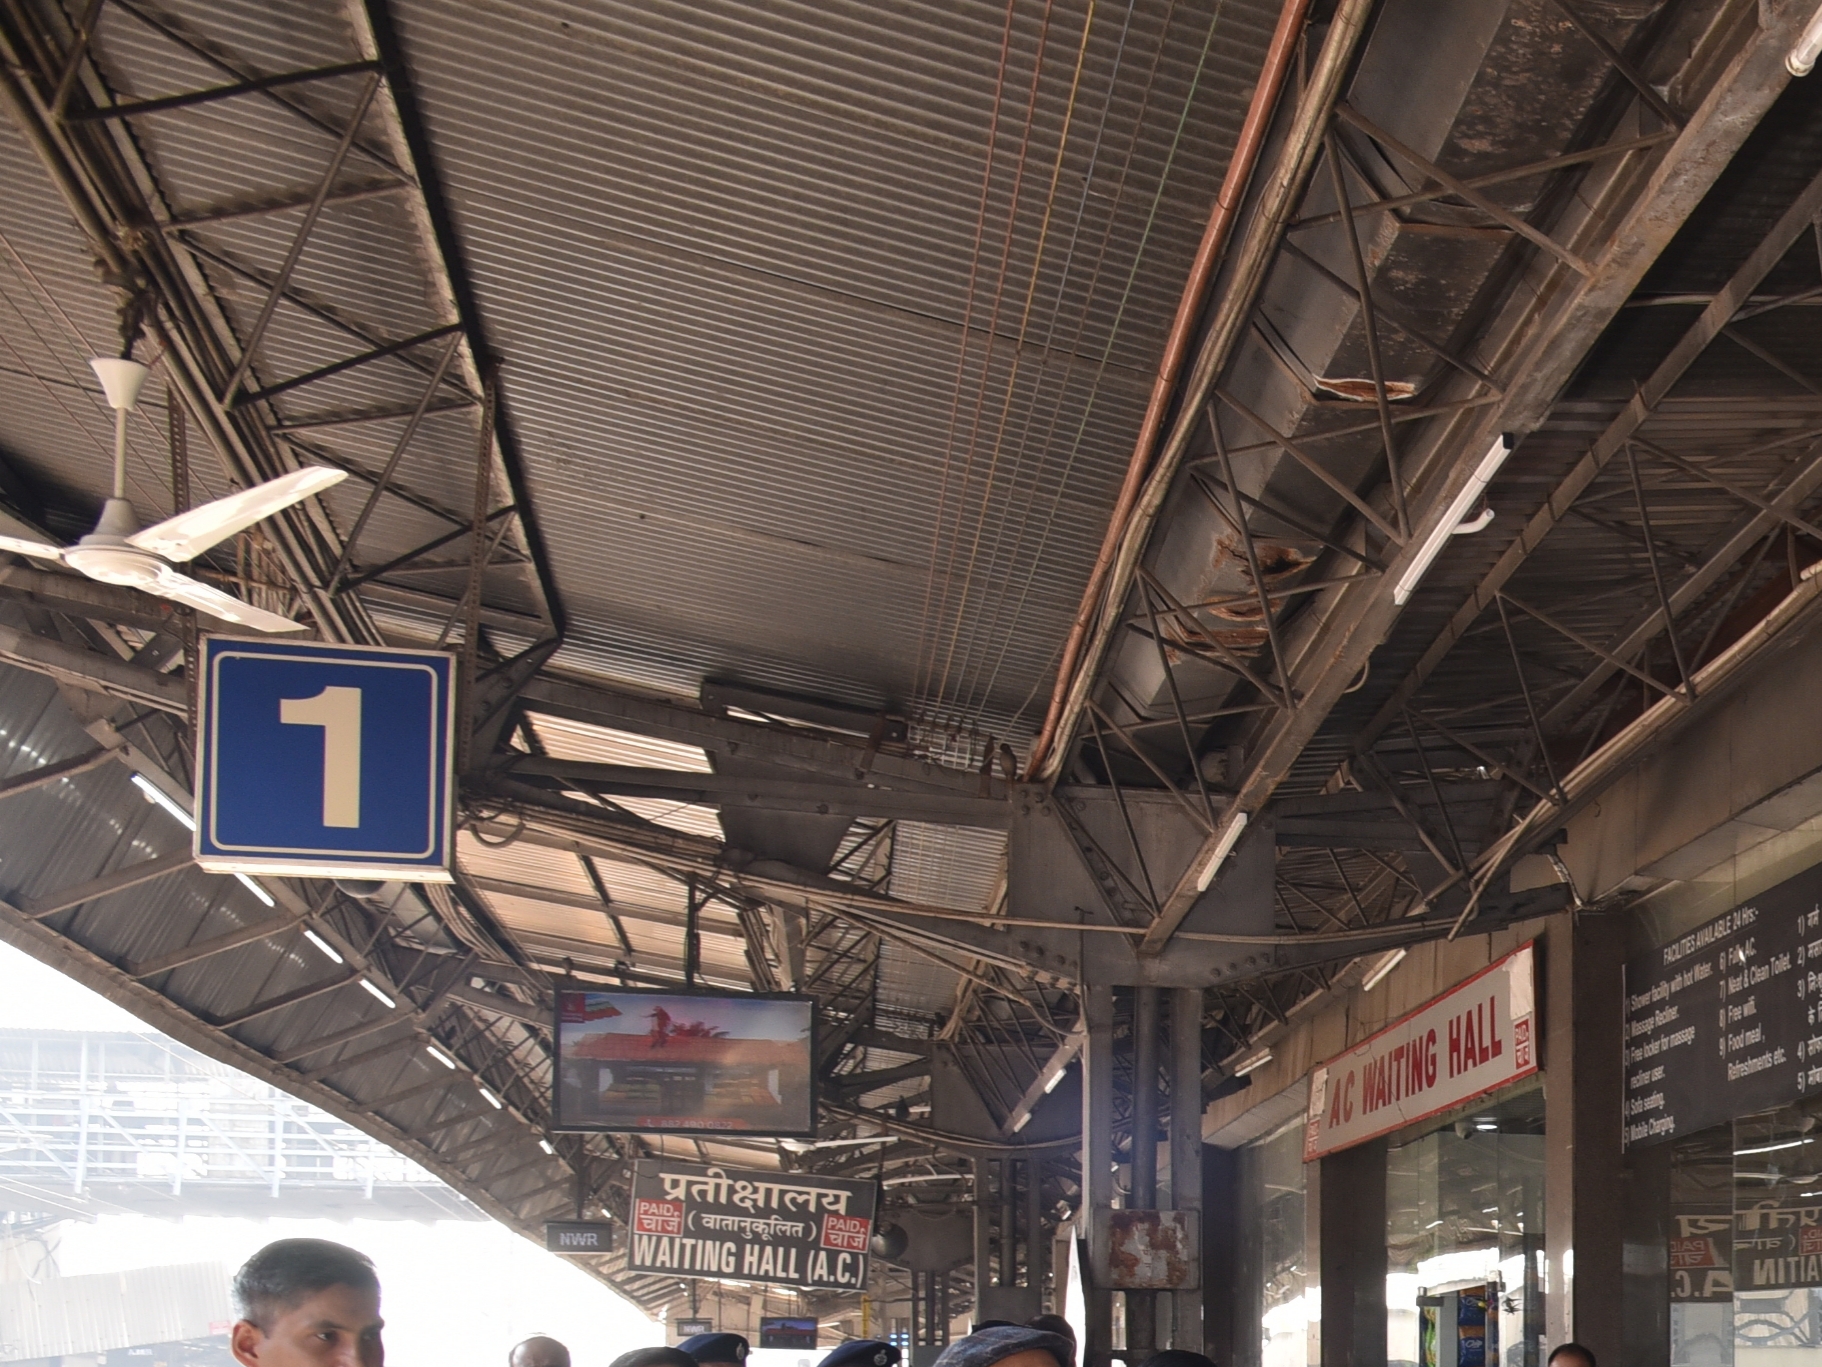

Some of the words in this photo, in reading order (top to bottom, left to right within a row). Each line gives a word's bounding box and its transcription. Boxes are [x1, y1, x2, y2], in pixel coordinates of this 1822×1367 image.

[280, 685, 362, 828] 1
[1797, 915, 1806, 937] 1)
[1663, 934, 1696, 966] FACILITIES
[1696, 915, 1732, 950] AVAILABLE
[1797, 945, 1806, 967] 2)
[1797, 978, 1806, 1001] 3)
[1808, 1006, 1816, 1026] के
[1362, 1028, 1438, 1115] WAITING
[1448, 995, 1503, 1079] HALL
[1797, 1040, 1806, 1063] 4)
[658, 1168, 852, 1216] प्रतीक्षालय
[639, 1201, 674, 1216] PAID
[827, 1216, 859, 1231] PAID
[559, 1232, 600, 1247] NWR
[633, 1234, 736, 1274] WAITING
[743, 1247, 800, 1280] HALL
[807, 1248, 866, 1289] (A.C.)
